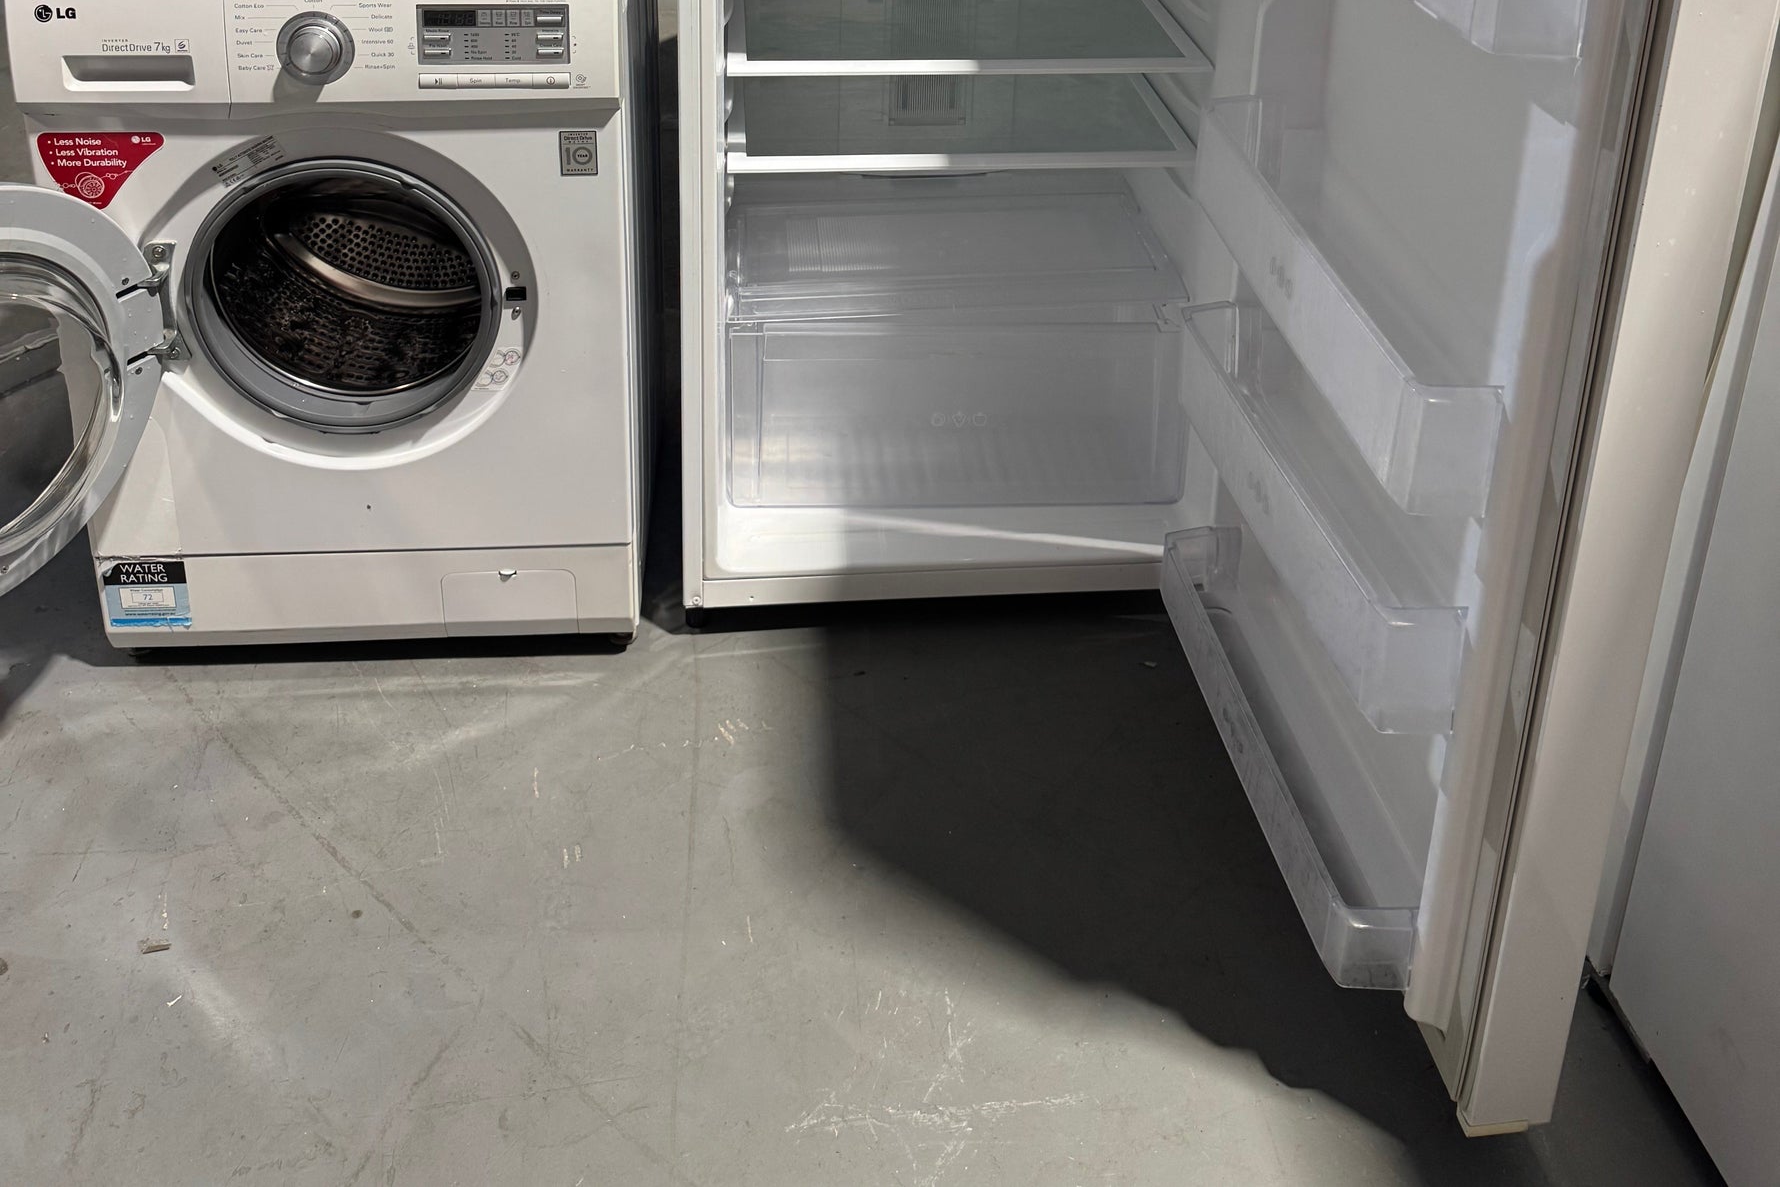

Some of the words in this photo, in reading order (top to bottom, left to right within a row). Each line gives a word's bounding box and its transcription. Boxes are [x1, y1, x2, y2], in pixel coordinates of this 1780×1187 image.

[56, 7, 77, 19] LG
[54, 138, 74, 146] Less
[75, 138, 102, 146] Noise
[77, 148, 119, 156] Vibration
[57, 159, 81, 167] More
[83, 159, 127, 168] Durability
[120, 564, 166, 573] WATER
[120, 574, 168, 583] RATING
